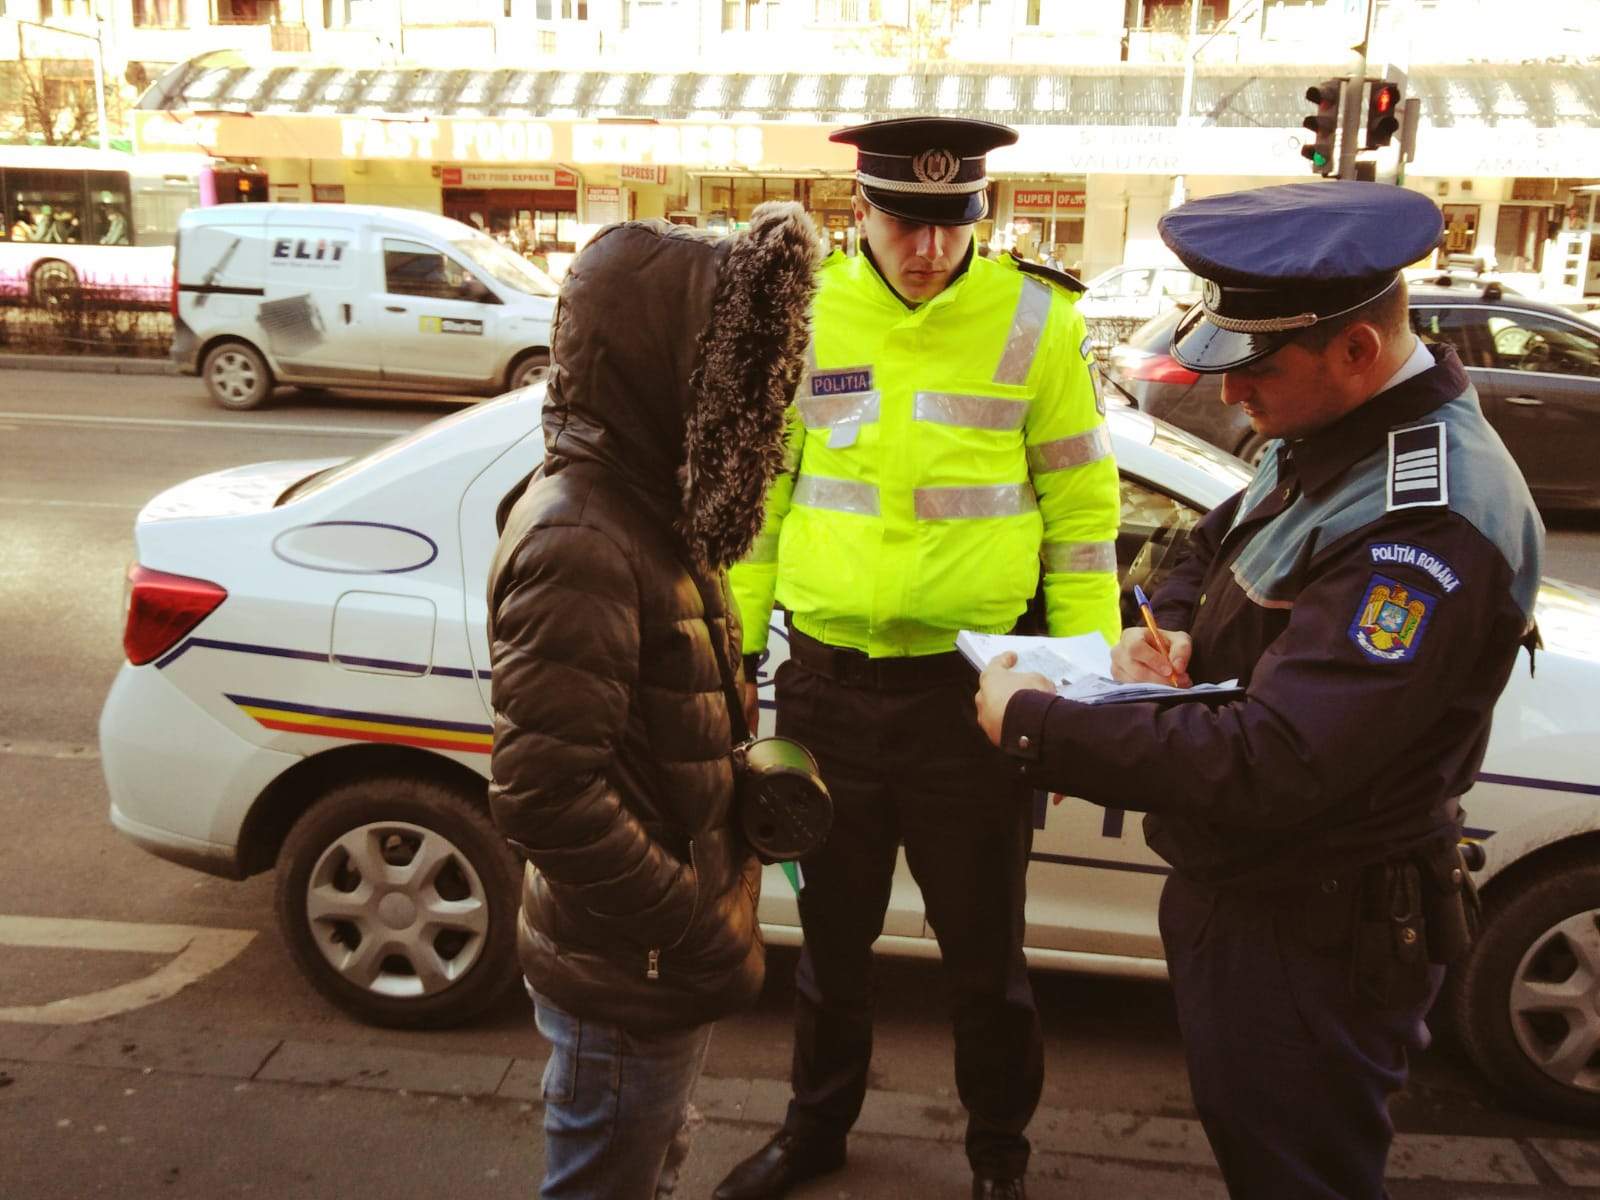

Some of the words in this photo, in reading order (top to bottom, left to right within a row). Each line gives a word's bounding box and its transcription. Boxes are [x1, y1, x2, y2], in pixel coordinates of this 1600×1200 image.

[341, 119, 439, 158] FAST
[451, 120, 553, 161] FOOD
[573, 124, 762, 166] EXPRESS
[1016, 193, 1052, 205] SUPER
